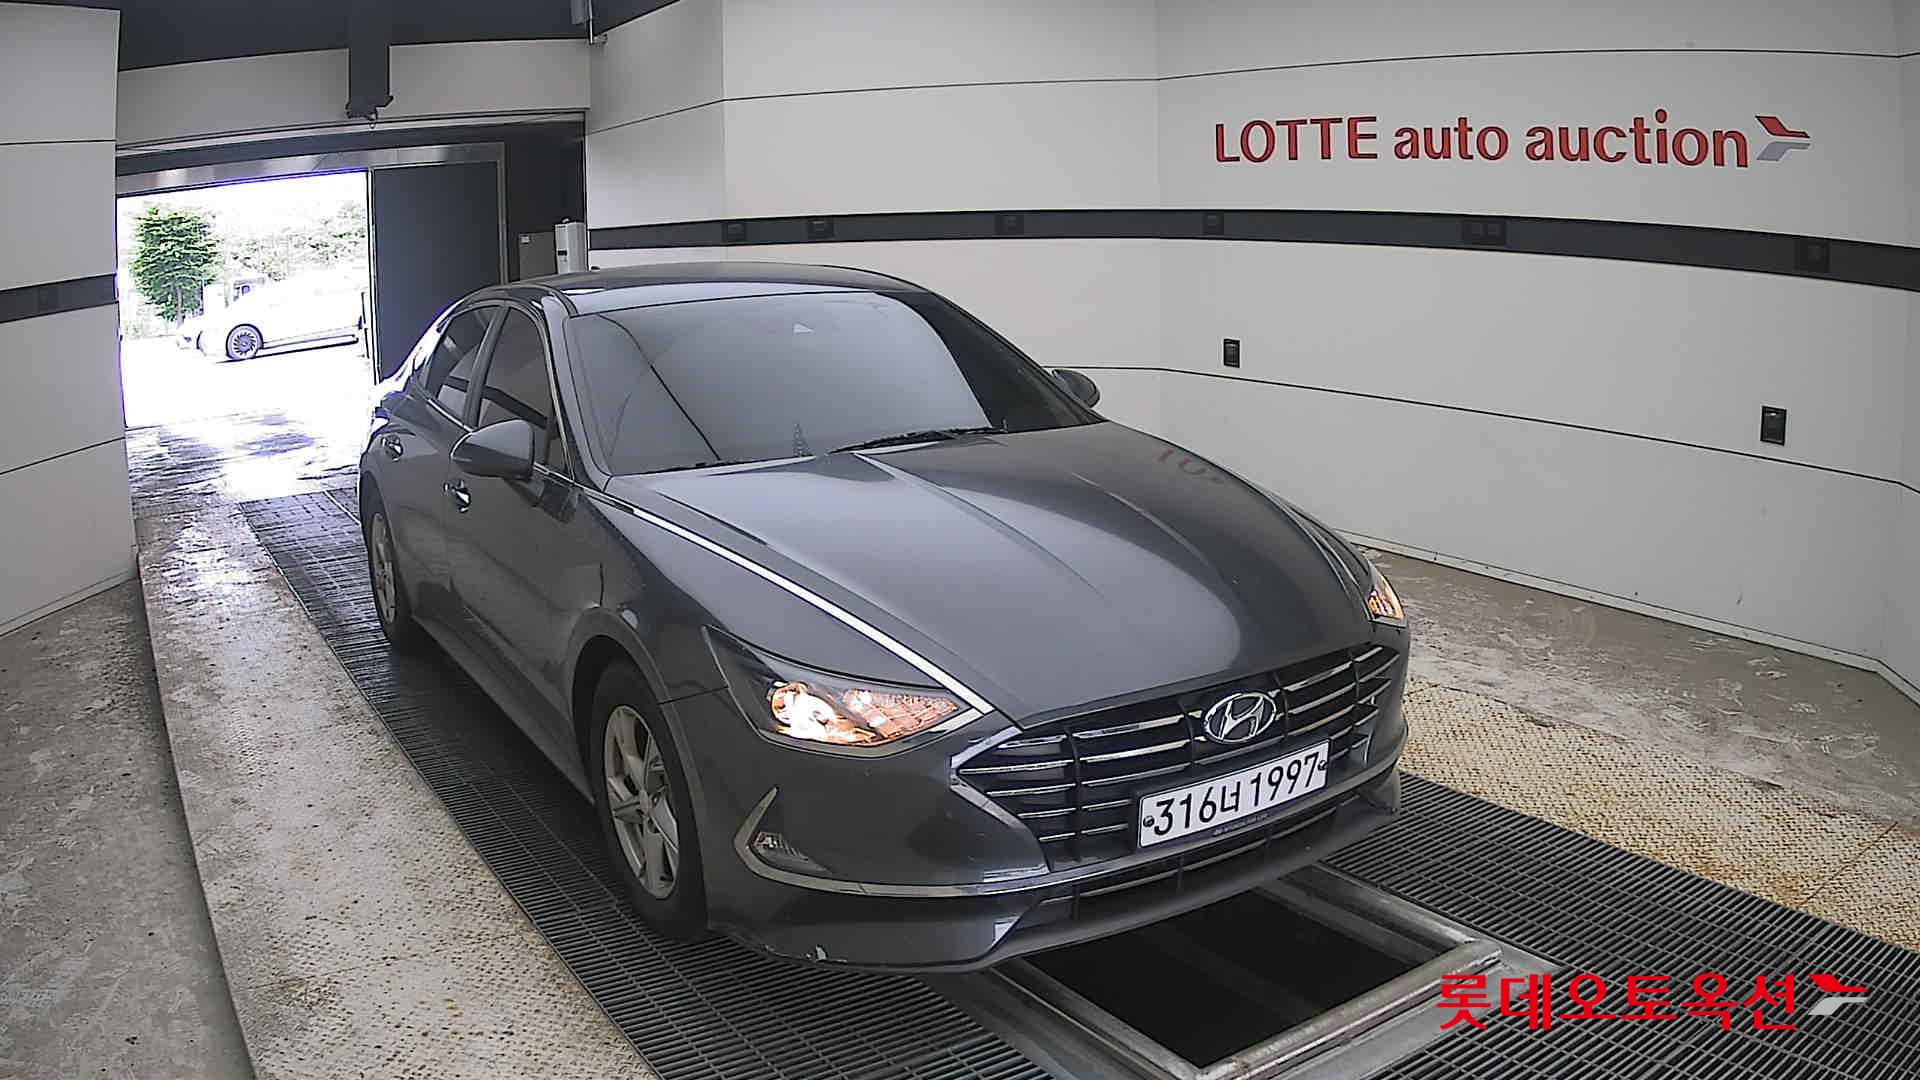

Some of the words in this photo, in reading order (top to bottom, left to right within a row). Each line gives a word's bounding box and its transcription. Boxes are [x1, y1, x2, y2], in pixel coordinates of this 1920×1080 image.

[1215, 115, 1378, 163] LOTTE
[1393, 116, 1510, 162] auto
[1524, 108, 1750, 168] auction
[1153, 781, 1241, 836] 316너
[1250, 751, 1320, 807] 1997
